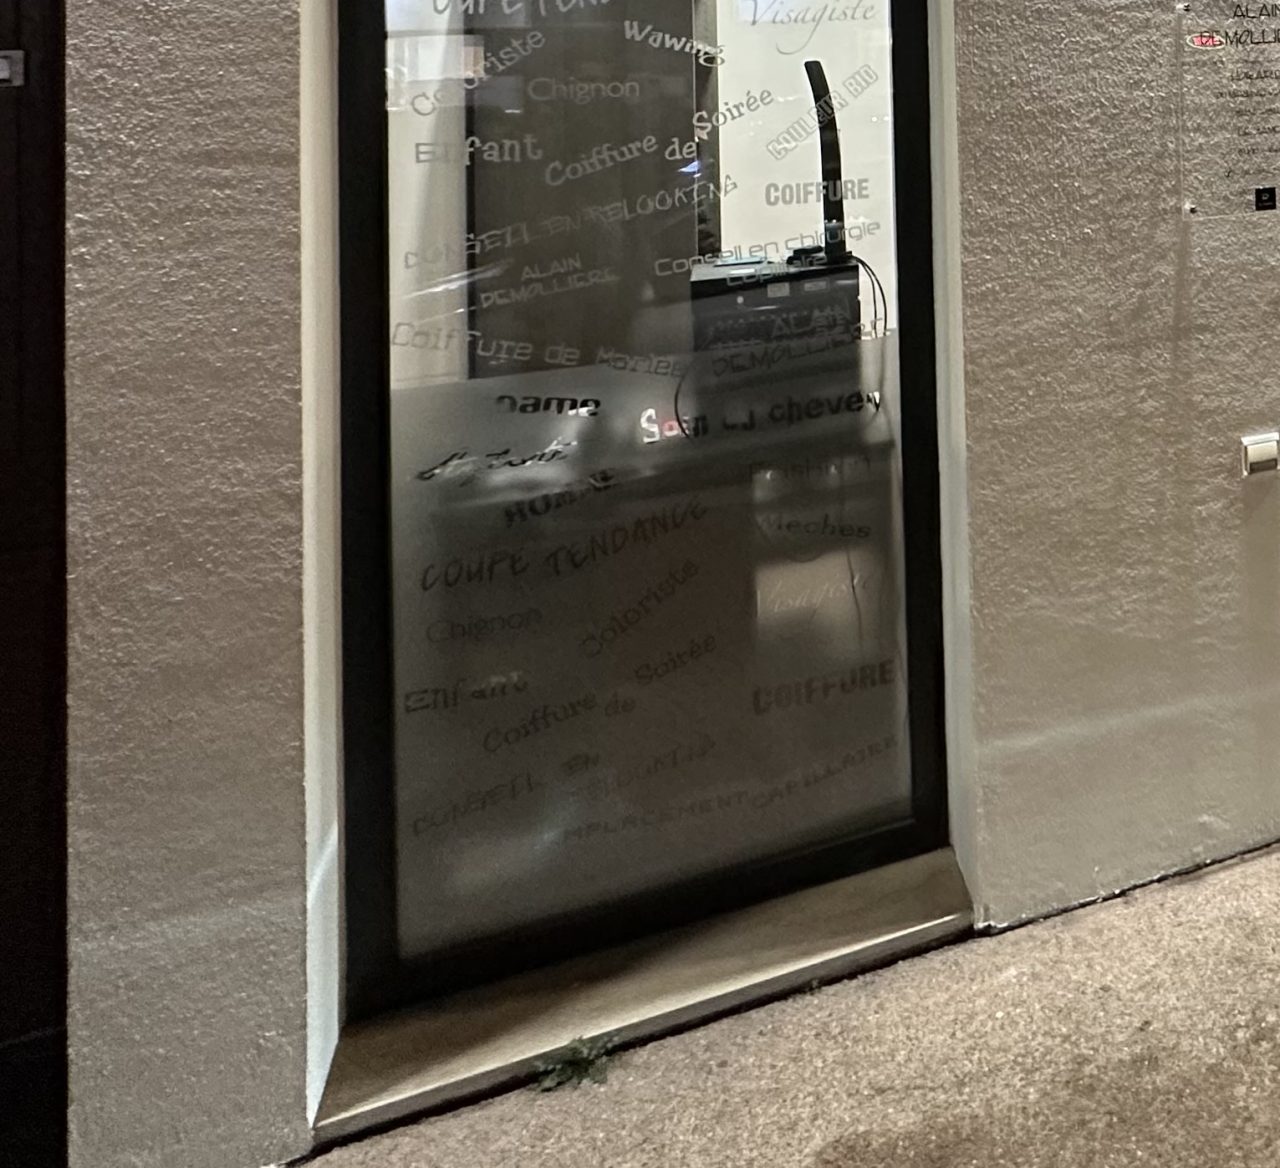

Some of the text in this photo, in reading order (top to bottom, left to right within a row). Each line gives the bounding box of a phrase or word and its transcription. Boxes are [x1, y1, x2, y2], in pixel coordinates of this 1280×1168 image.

[623, 19, 726, 67] Wawing
[527, 76, 641, 105] Chignon
[766, 63, 879, 161] COULEUR BIO
[544, 89, 775, 187] Coiffure de Soirée
[764, 177, 870, 206] COIFFURE
[521, 252, 582, 282] ALAIN
[653, 219, 882, 278] Conseil en chirurgie
[479, 266, 622, 309] DEMOLLIERE
[543, 341, 581, 366] de
[420, 546, 530, 592] COUPE
[751, 658, 895, 716] COIFFURE
[482, 692, 598, 754] Coiffure
